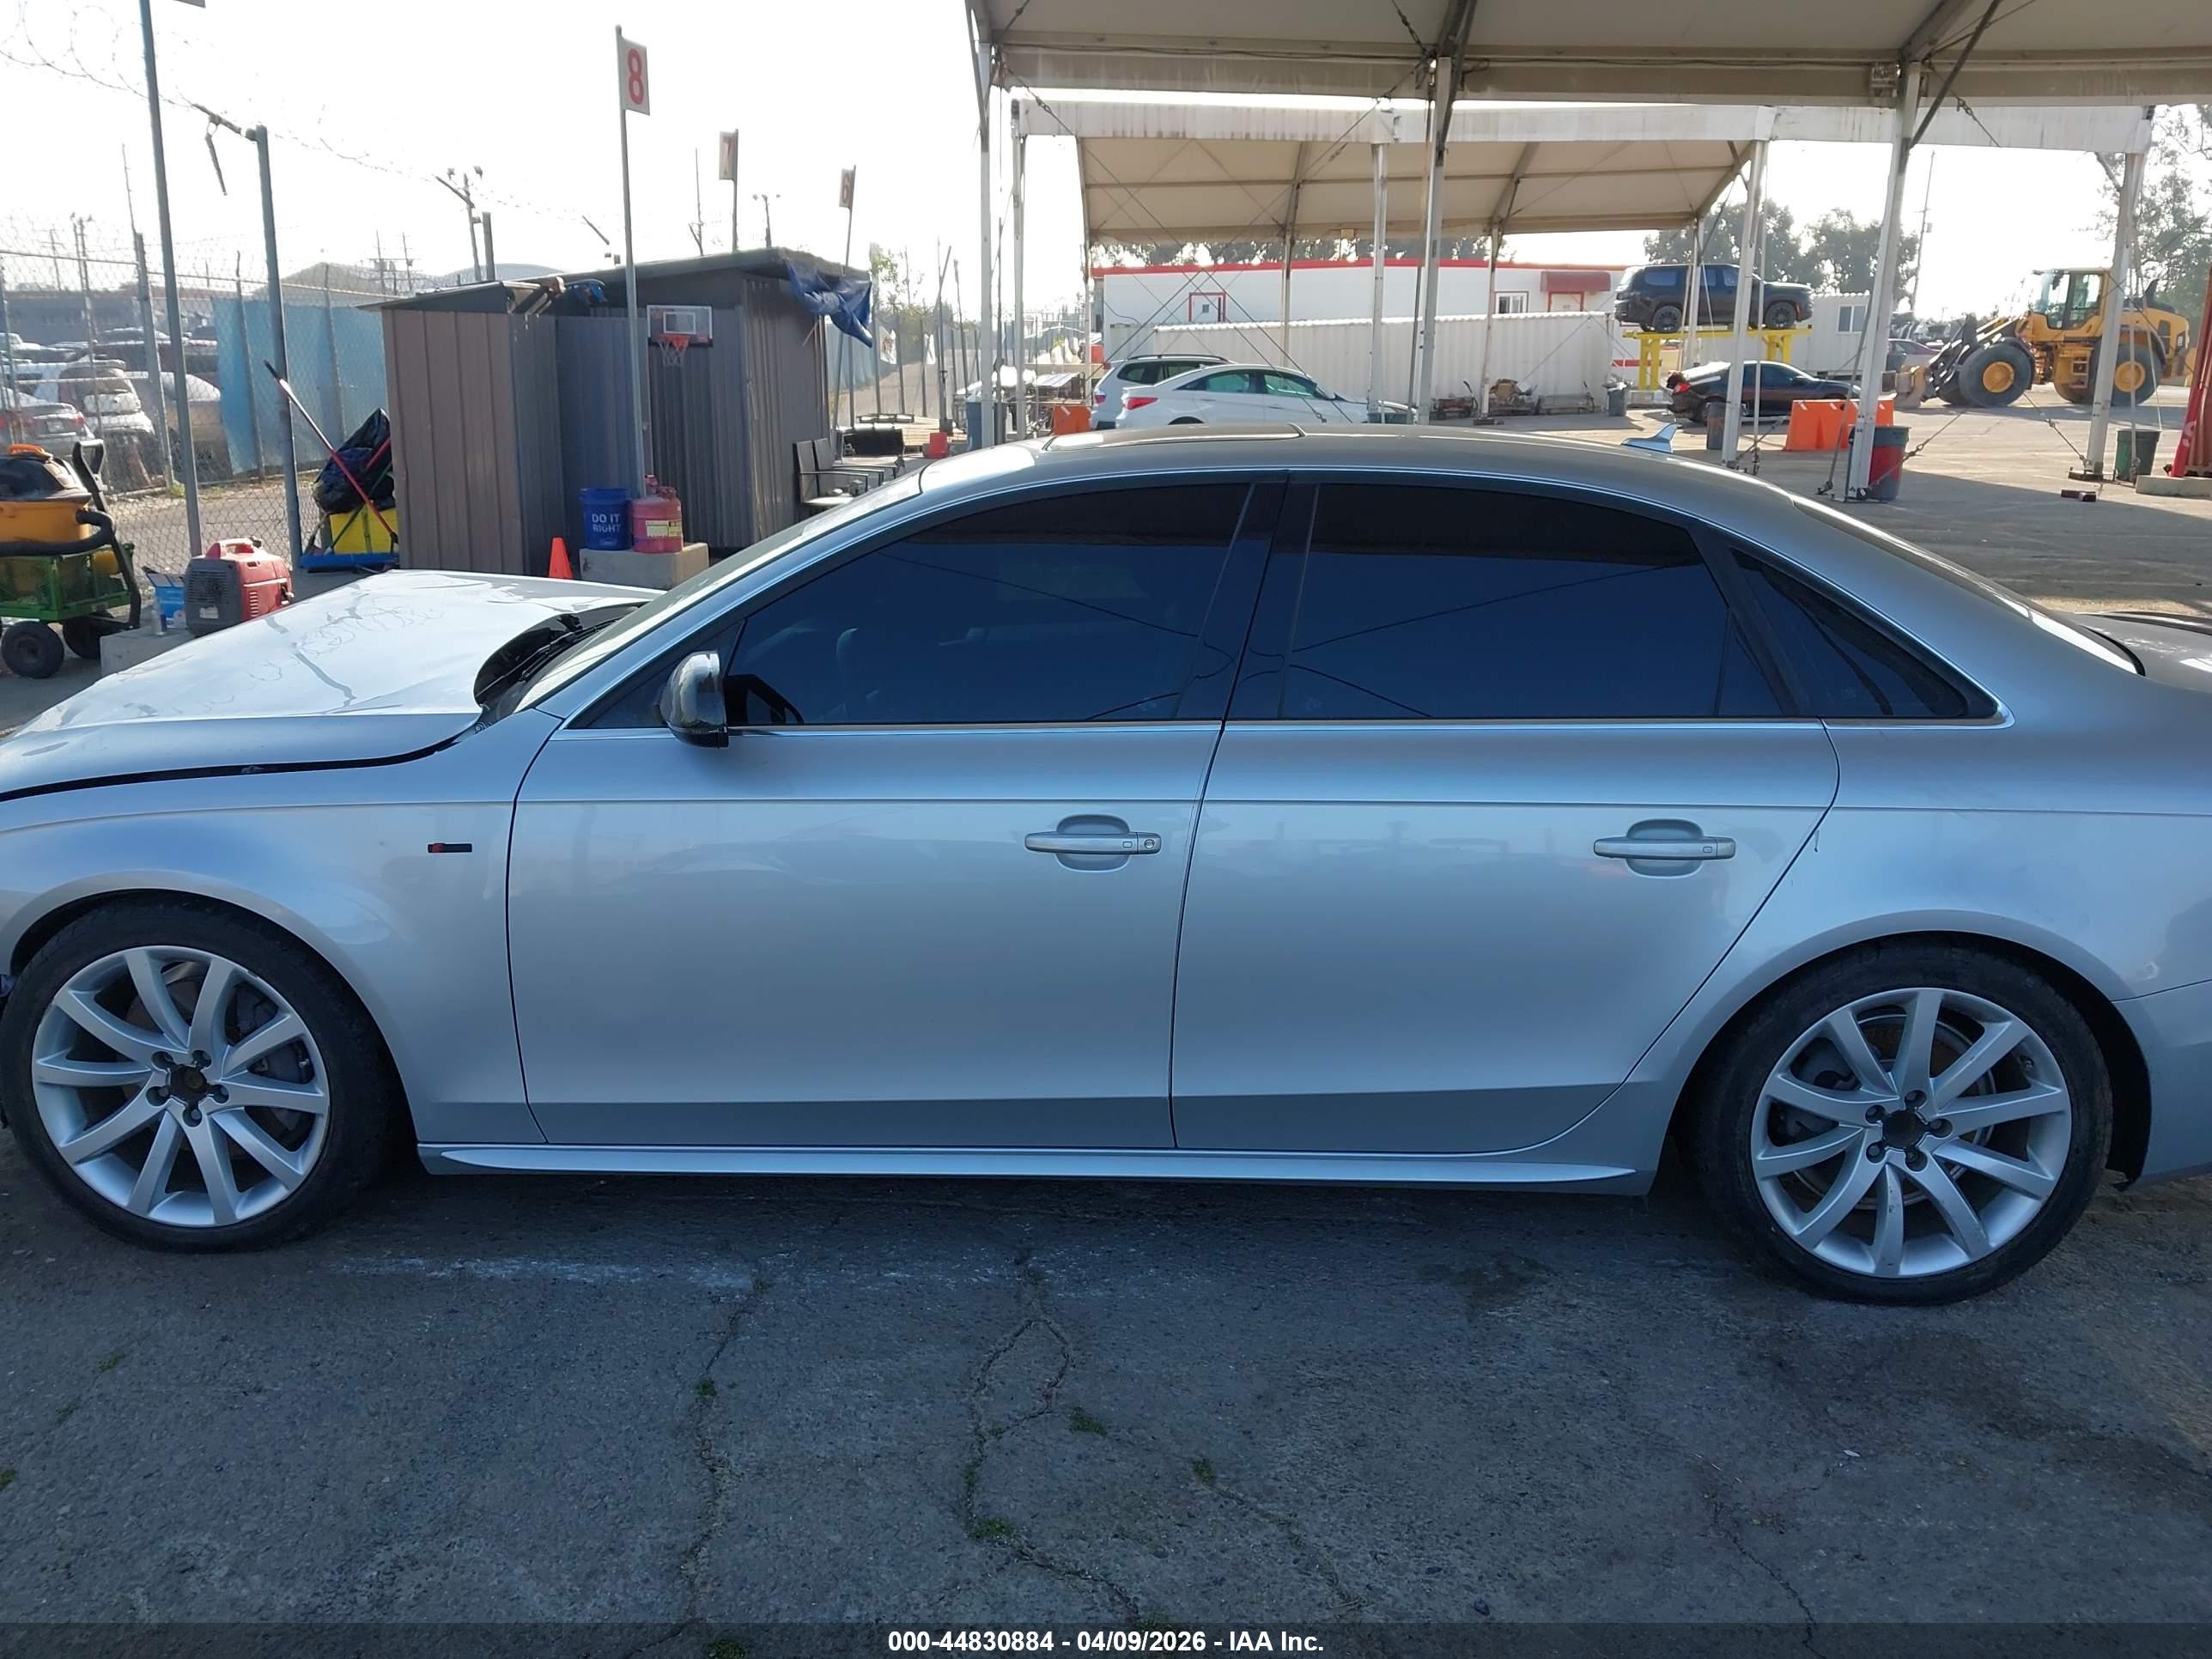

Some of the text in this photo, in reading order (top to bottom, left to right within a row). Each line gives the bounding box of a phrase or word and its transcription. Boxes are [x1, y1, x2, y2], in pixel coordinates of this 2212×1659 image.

[628, 47, 644, 105] 8
[722, 135, 733, 176] 7
[842, 172, 851, 204] 6
[592, 514, 621, 523] DO IT
[592, 524, 621, 532] RIGHT
